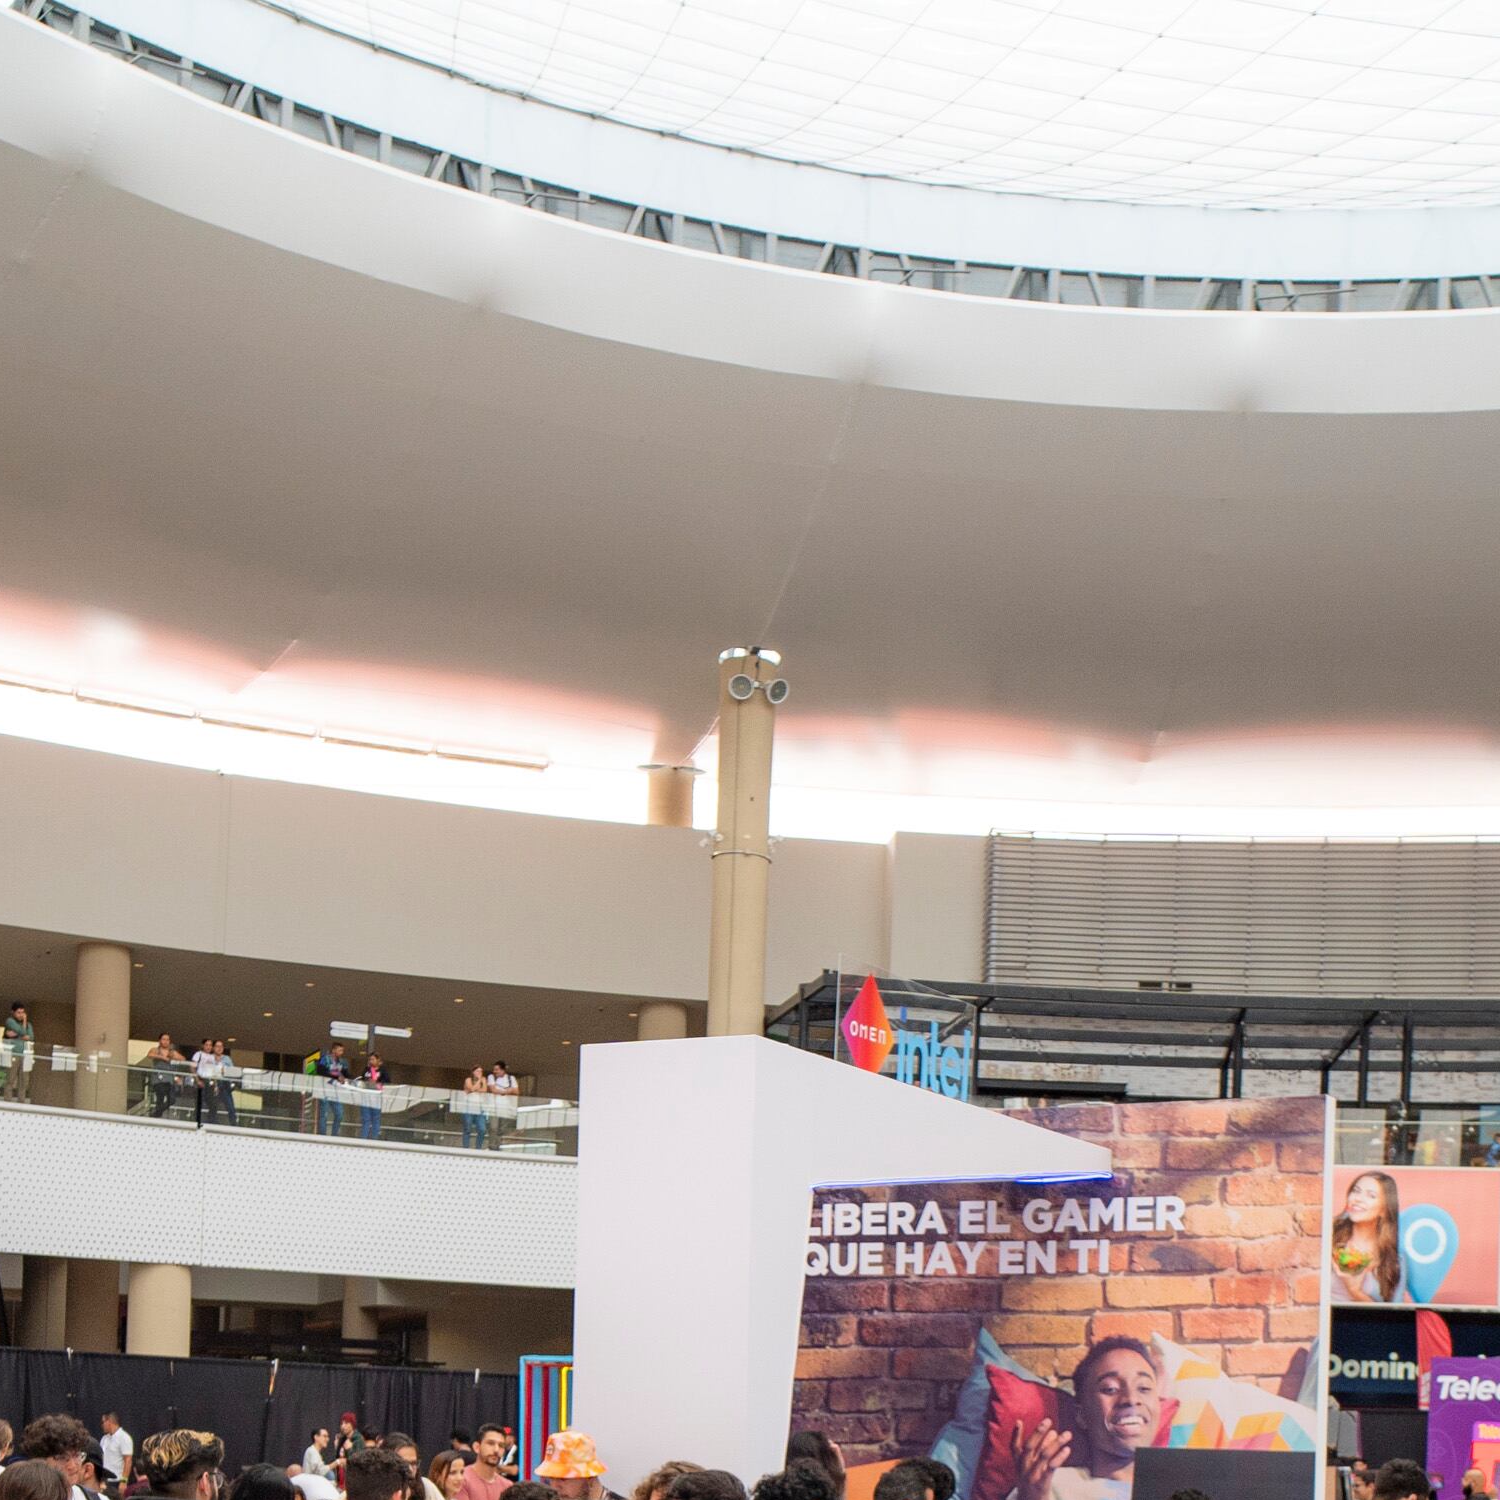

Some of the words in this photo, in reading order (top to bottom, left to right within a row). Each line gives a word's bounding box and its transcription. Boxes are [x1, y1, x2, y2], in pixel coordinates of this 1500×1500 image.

[850, 1020, 886, 1045] OMEN
[897, 1007, 971, 1103] intel
[959, 1200, 1011, 1234] EL
[1022, 1195, 1186, 1232] GAMER
[804, 1242, 886, 1276] QUE
[895, 1241, 988, 1276] HAY
[1000, 1240, 1056, 1275] EN
[1069, 1239, 1110, 1273] TI
[1328, 1352, 1419, 1381] Domin
